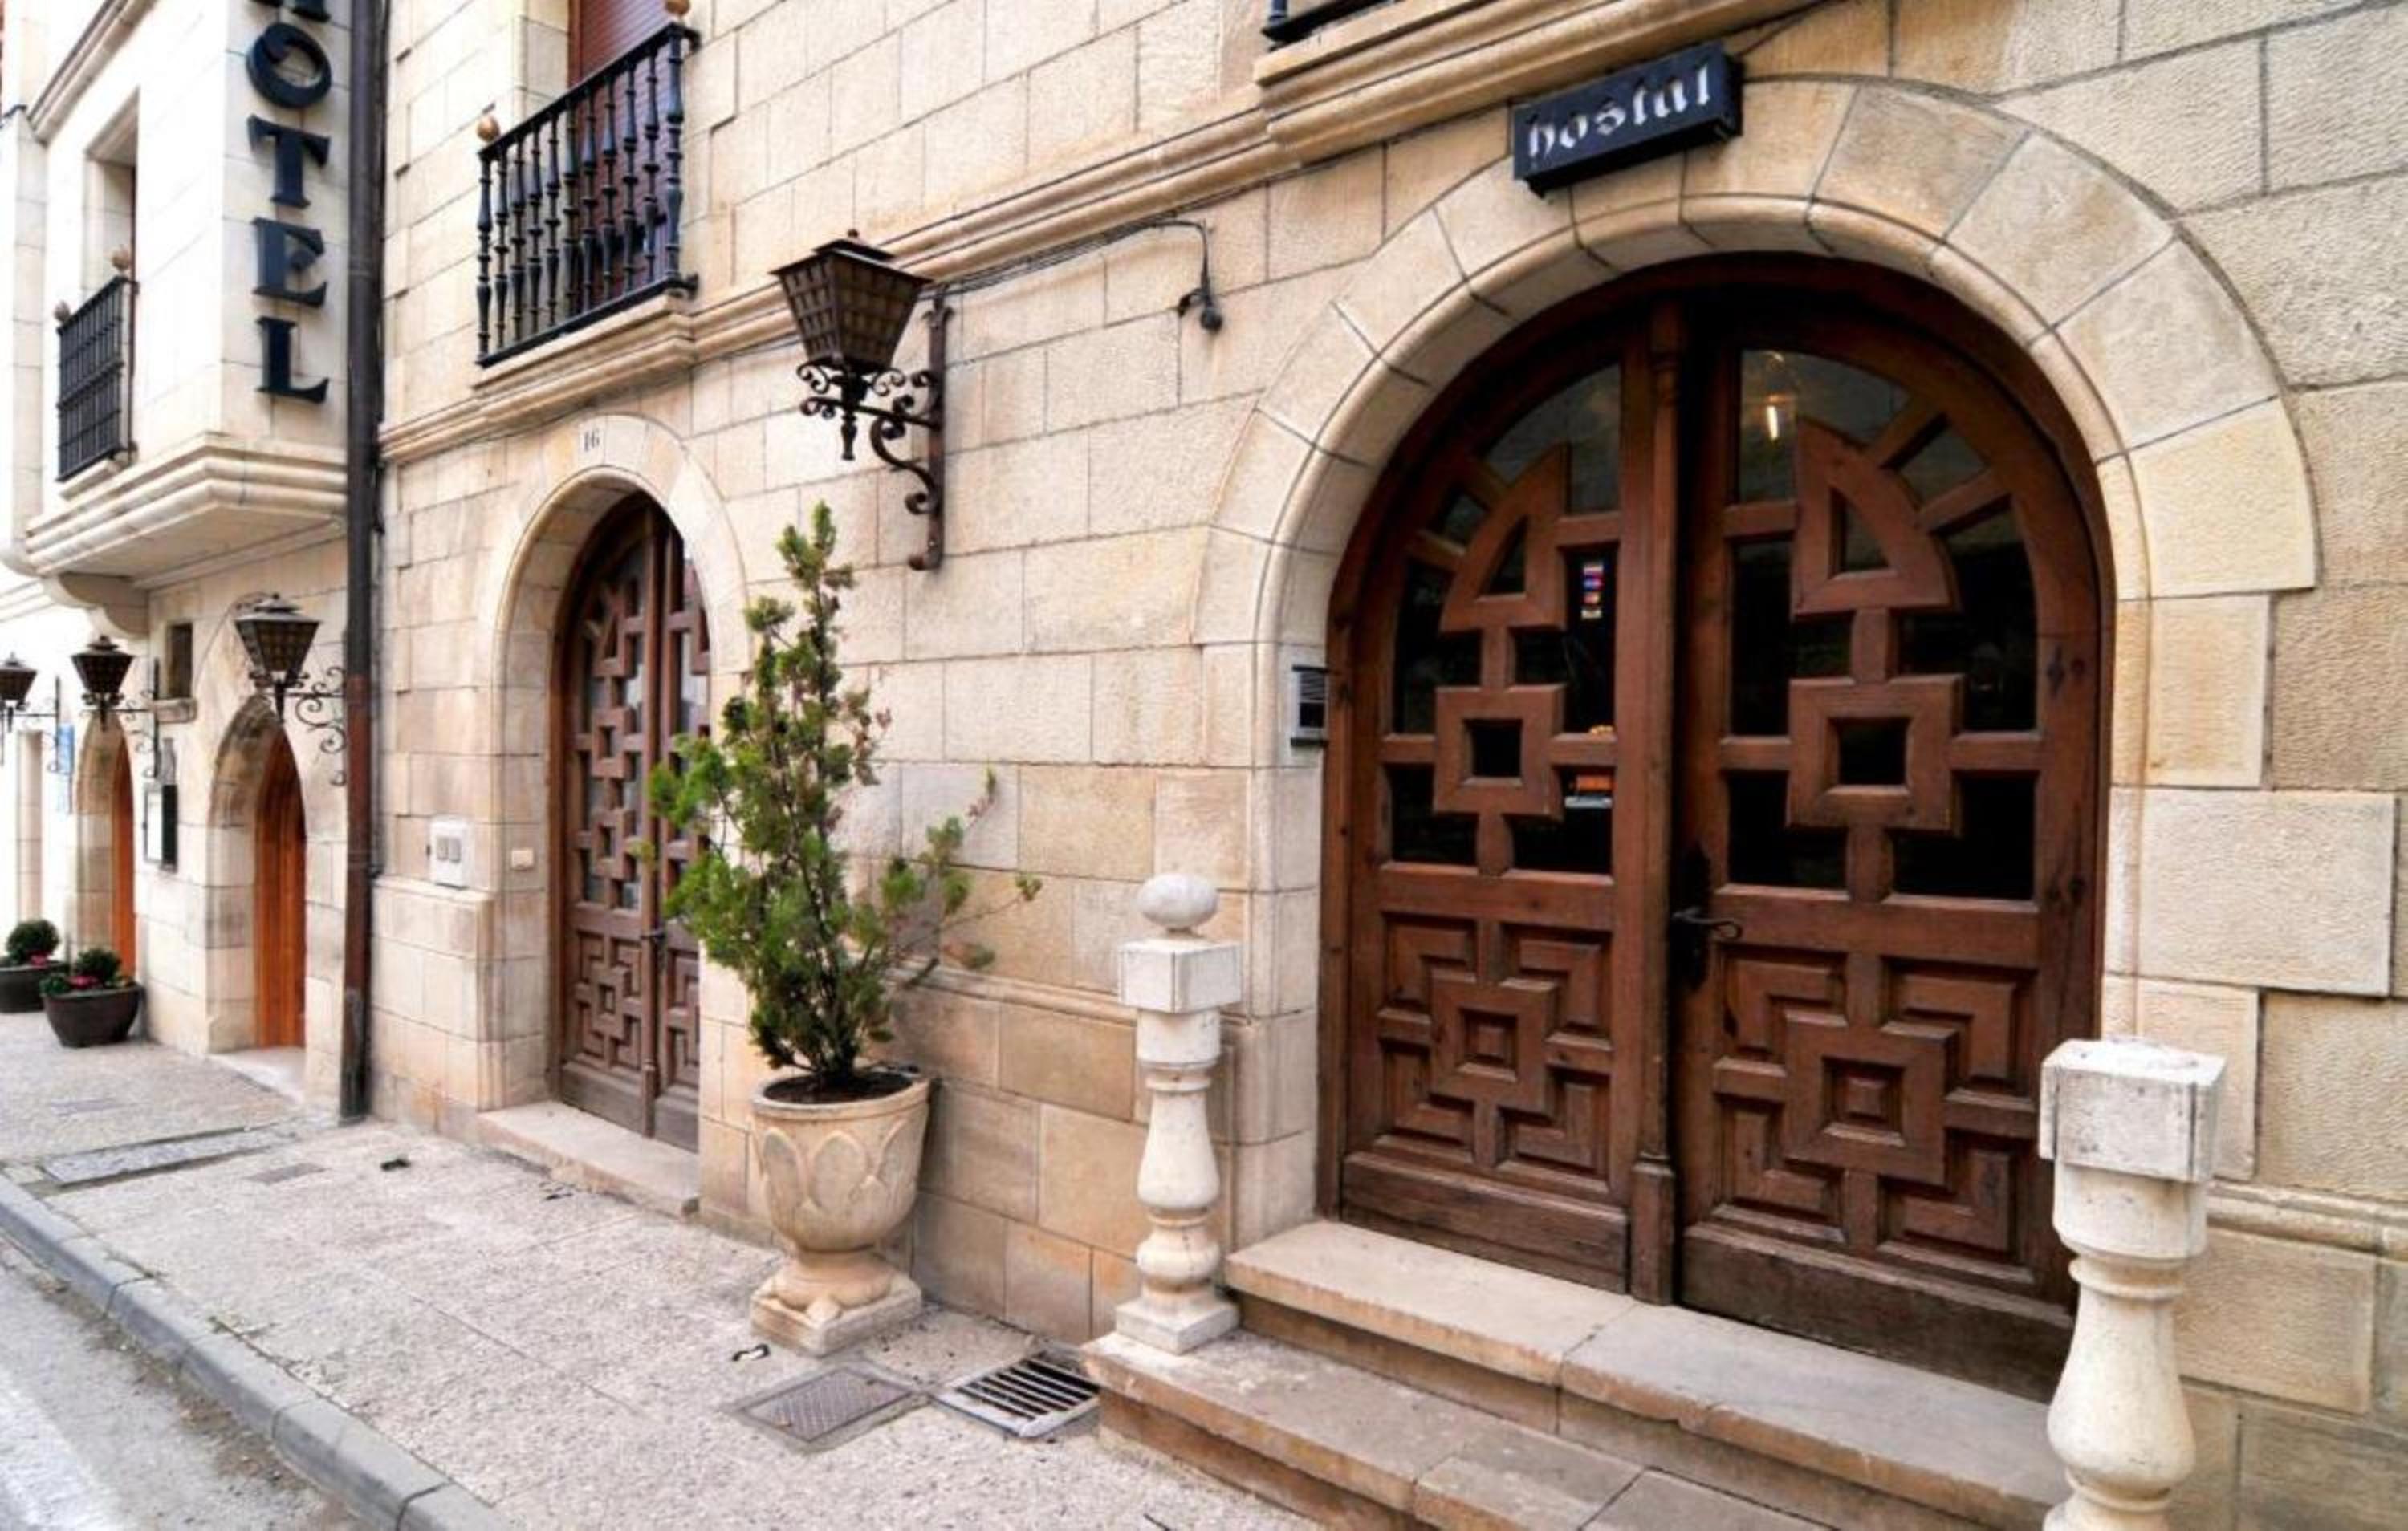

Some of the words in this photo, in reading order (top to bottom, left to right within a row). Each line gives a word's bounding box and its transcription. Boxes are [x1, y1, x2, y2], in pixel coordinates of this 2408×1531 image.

[1527, 63, 1711, 158] hostal
[246, 0, 332, 403] OTEL
[584, 428, 600, 452] 16
